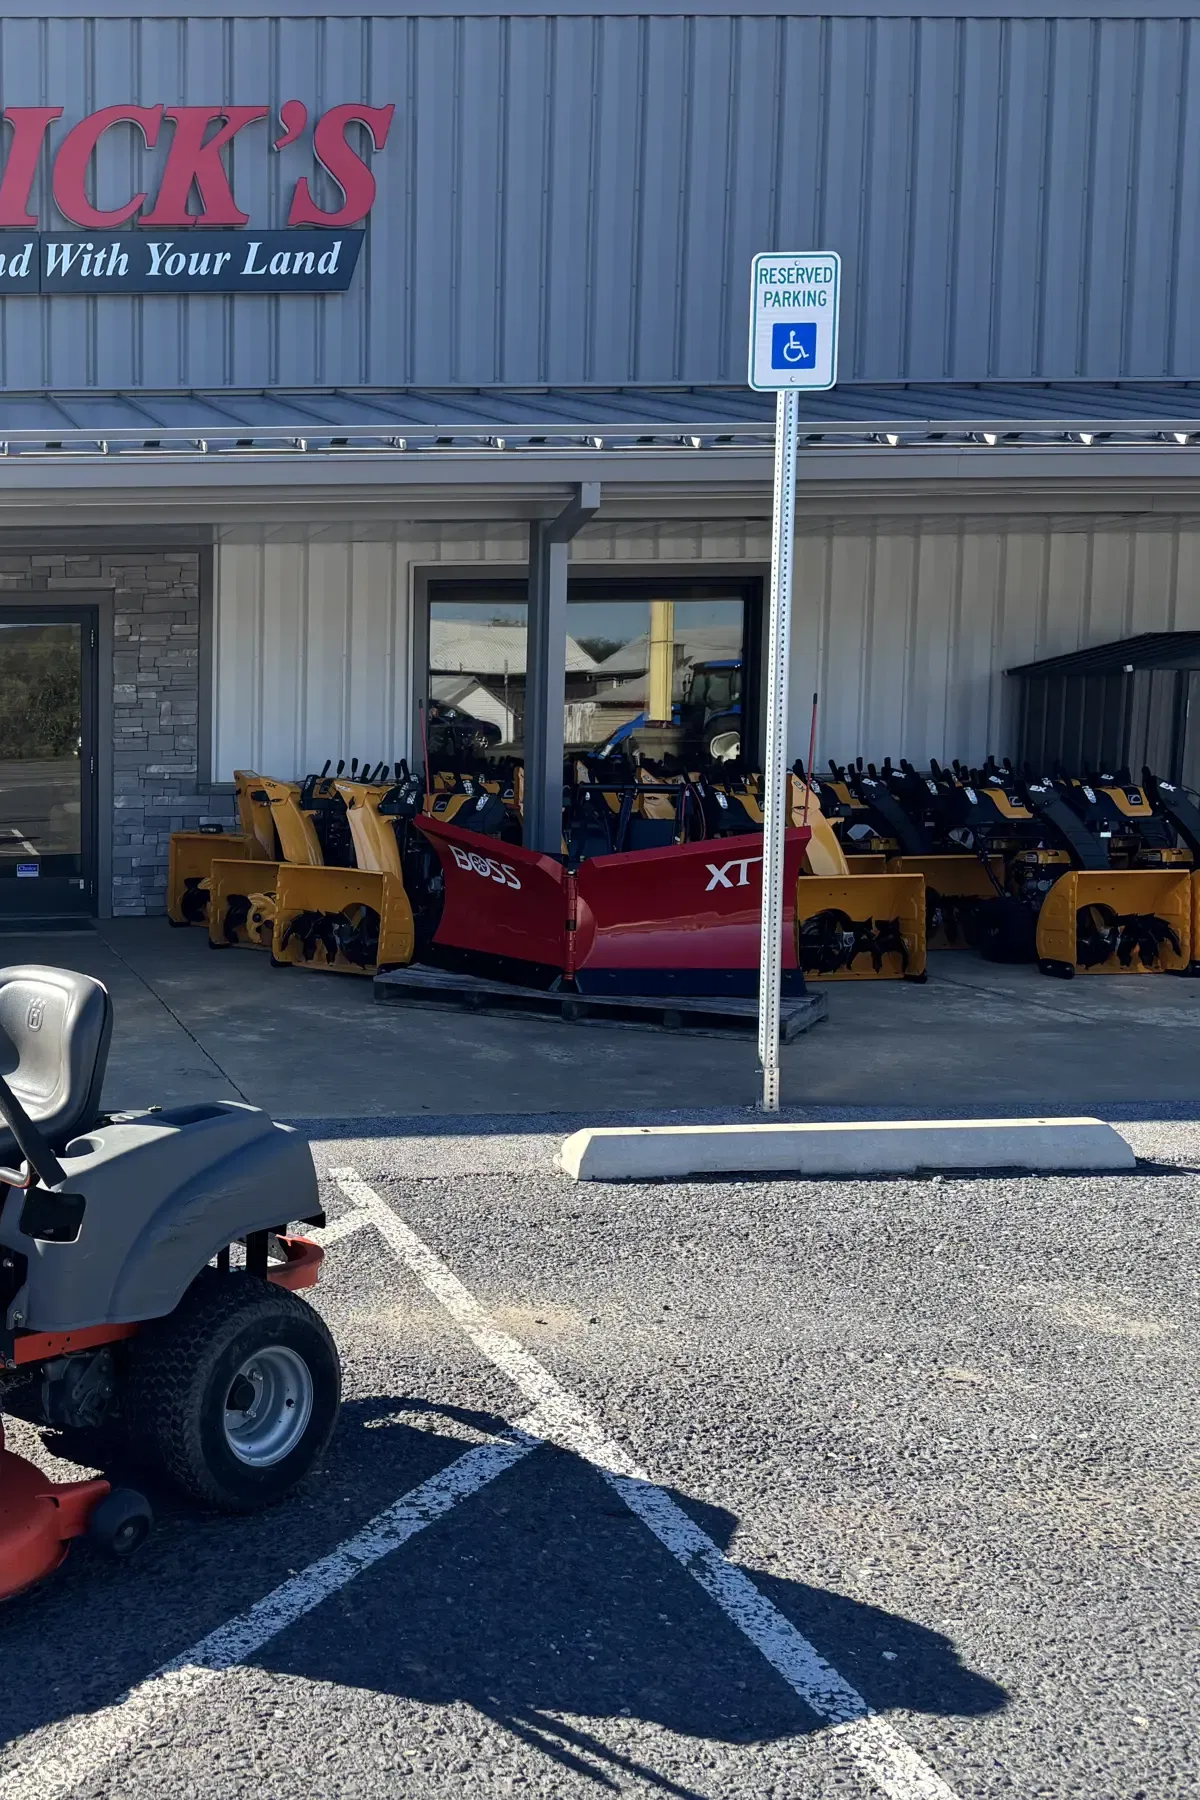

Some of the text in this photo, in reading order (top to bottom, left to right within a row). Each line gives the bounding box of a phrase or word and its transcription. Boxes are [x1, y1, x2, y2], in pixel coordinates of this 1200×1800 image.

[46, 242, 129, 278] With
[146, 242, 231, 276] Your
[240, 241, 342, 275] Land
[760, 266, 833, 284] RESERVED
[764, 290, 827, 307] PARKING
[448, 844, 521, 890] BOSS
[705, 856, 763, 891] XT
